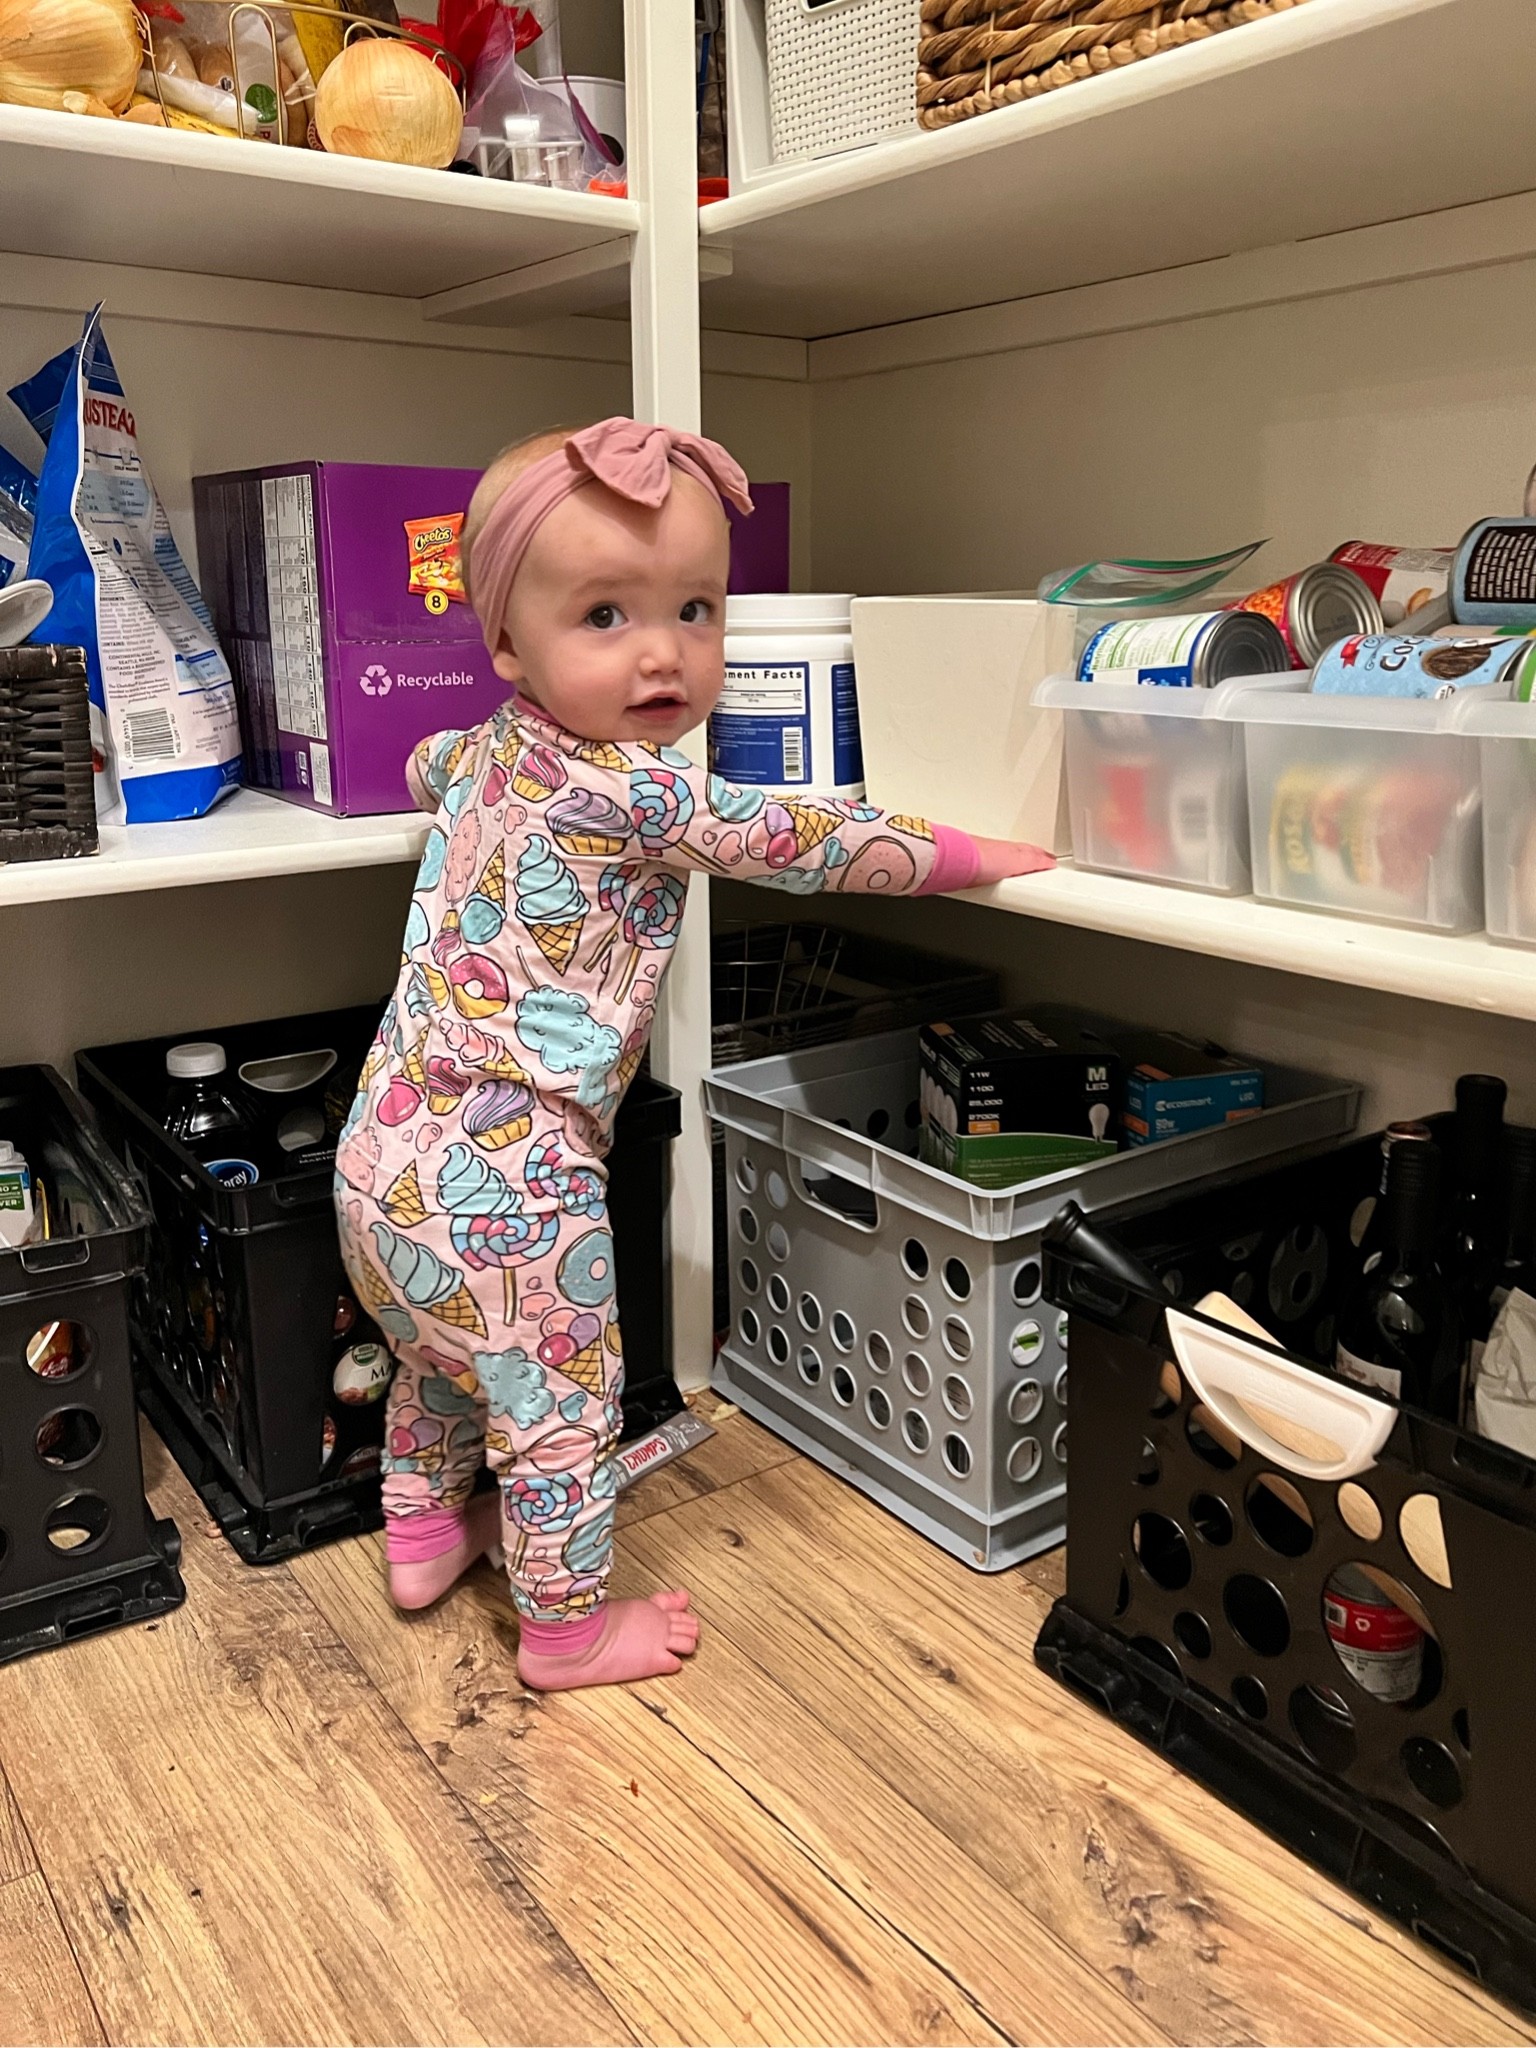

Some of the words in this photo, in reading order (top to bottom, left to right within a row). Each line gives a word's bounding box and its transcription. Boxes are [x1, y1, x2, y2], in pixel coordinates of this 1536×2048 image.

[414, 528, 452, 552] Cheetos
[432, 595, 441, 608] 8
[397, 673, 474, 688] Recyclable
[764, 670, 802, 679] Facts
[969, 1071, 991, 1079] 11W
[1087, 1066, 1107, 1081] M
[1086, 1082, 1109, 1091] LED
[622, 1437, 667, 1470] CHOMPS
